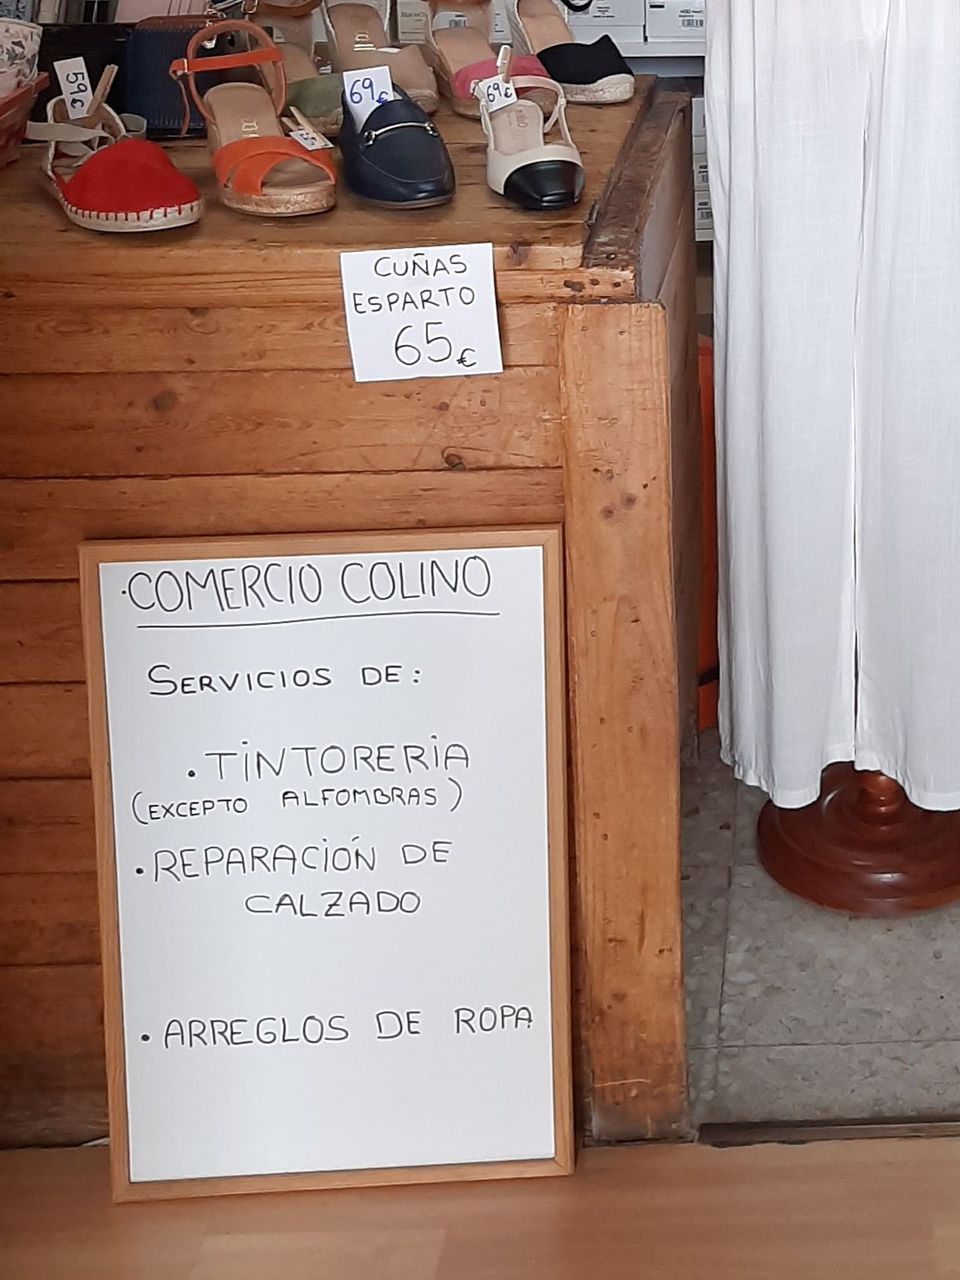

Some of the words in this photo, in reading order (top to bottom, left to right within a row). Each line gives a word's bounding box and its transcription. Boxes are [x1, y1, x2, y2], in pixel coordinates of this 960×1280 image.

[486, 82, 513, 103] 69€
[374, 253, 468, 277] CUÑAS
[353, 286, 475, 314] ESPARTO
[394, 321, 477, 368] 65€
[341, 555, 491, 605] COLINO
[402, 840, 452, 865] DE
[245, 890, 421, 917] CALZADO
[164, 1015, 349, 1049] ARREGLOS
[376, 1010, 421, 1040] DE
[454, 1004, 534, 1034] ROPA
